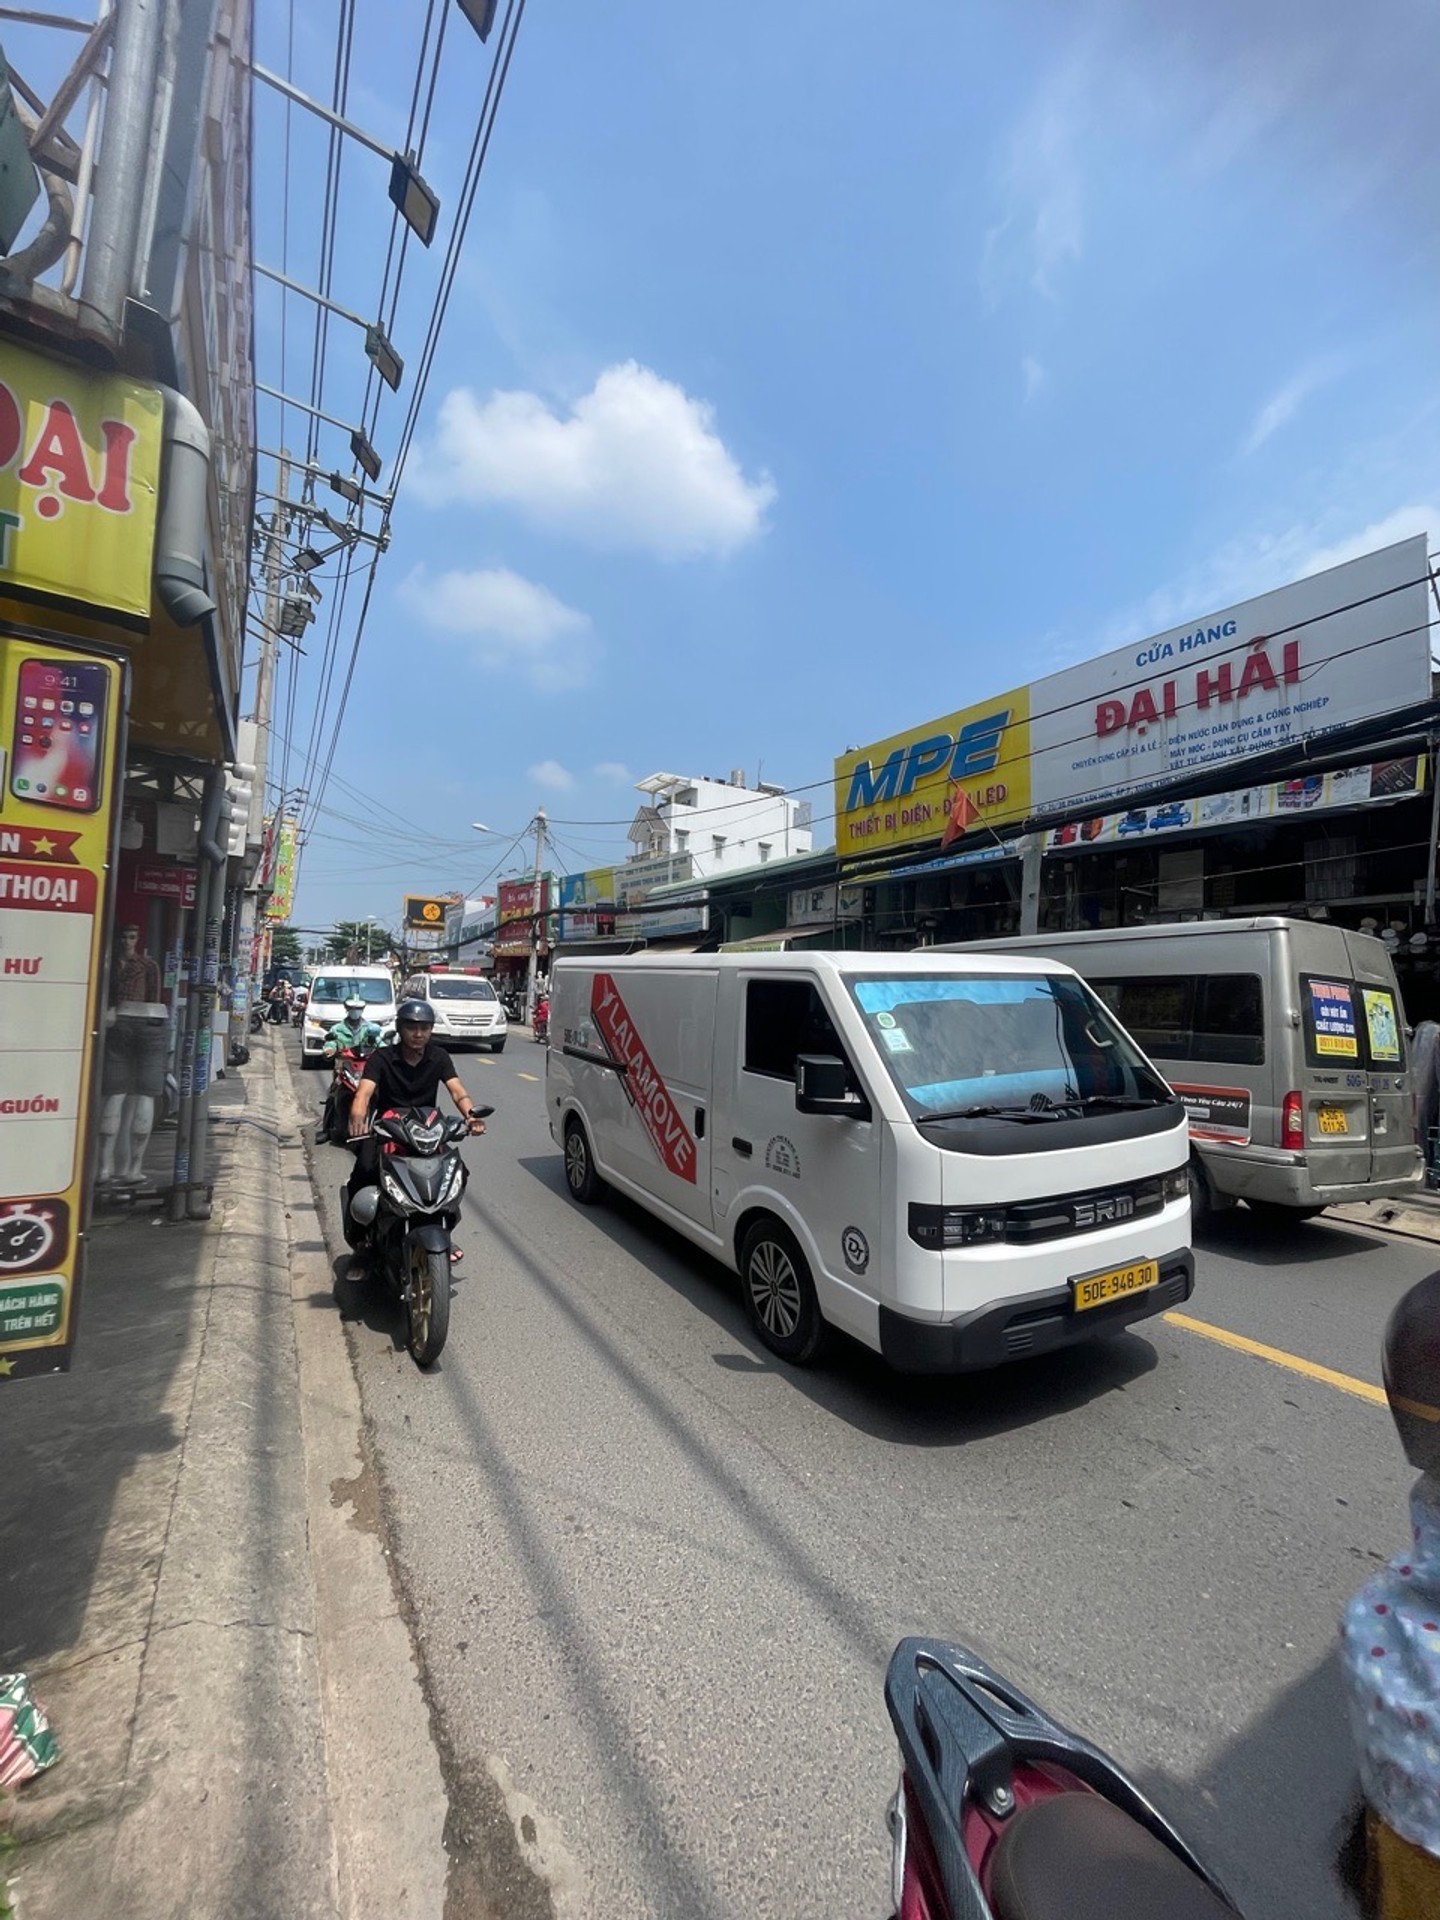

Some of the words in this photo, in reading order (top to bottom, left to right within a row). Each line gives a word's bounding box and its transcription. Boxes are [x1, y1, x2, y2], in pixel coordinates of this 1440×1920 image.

[0, 381, 135, 518] ẠI
[1136, 642, 1174, 667] CỬA
[1179, 620, 1237, 653] HÀNG
[1095, 679, 1177, 738] ĐẠI
[1197, 635, 1299, 710] HẢI
[1169, 732, 1187, 746] ĐIỆN
[1188, 727, 1210, 740] NƯỚC
[1212, 722, 1229, 735] DÂN
[1231, 716, 1254, 731] DỤNG
[1266, 707, 1291, 721] CÔNG
[1293, 697, 1330, 714] NGHIỆP
[1274, 722, 1292, 734] TAY
[846, 709, 1012, 812] MPE
[849, 812, 882, 839] THIẾT
[976, 784, 1008, 807] LED
[0, 873, 78, 908] THOẠI
[4, 957, 43, 974] HƯ
[609, 1001, 693, 1171] LALAMOVE
[1226, 1100, 1244, 1109] 24/7
[1073, 1195, 1134, 1228] SRM
[28, 1292, 58, 1308] HÀNG
[1082, 1266, 1152, 1303] 50E-948.30
[4, 1314, 32, 1331] TRÊN
[34, 1309, 56, 1328] HẾT
